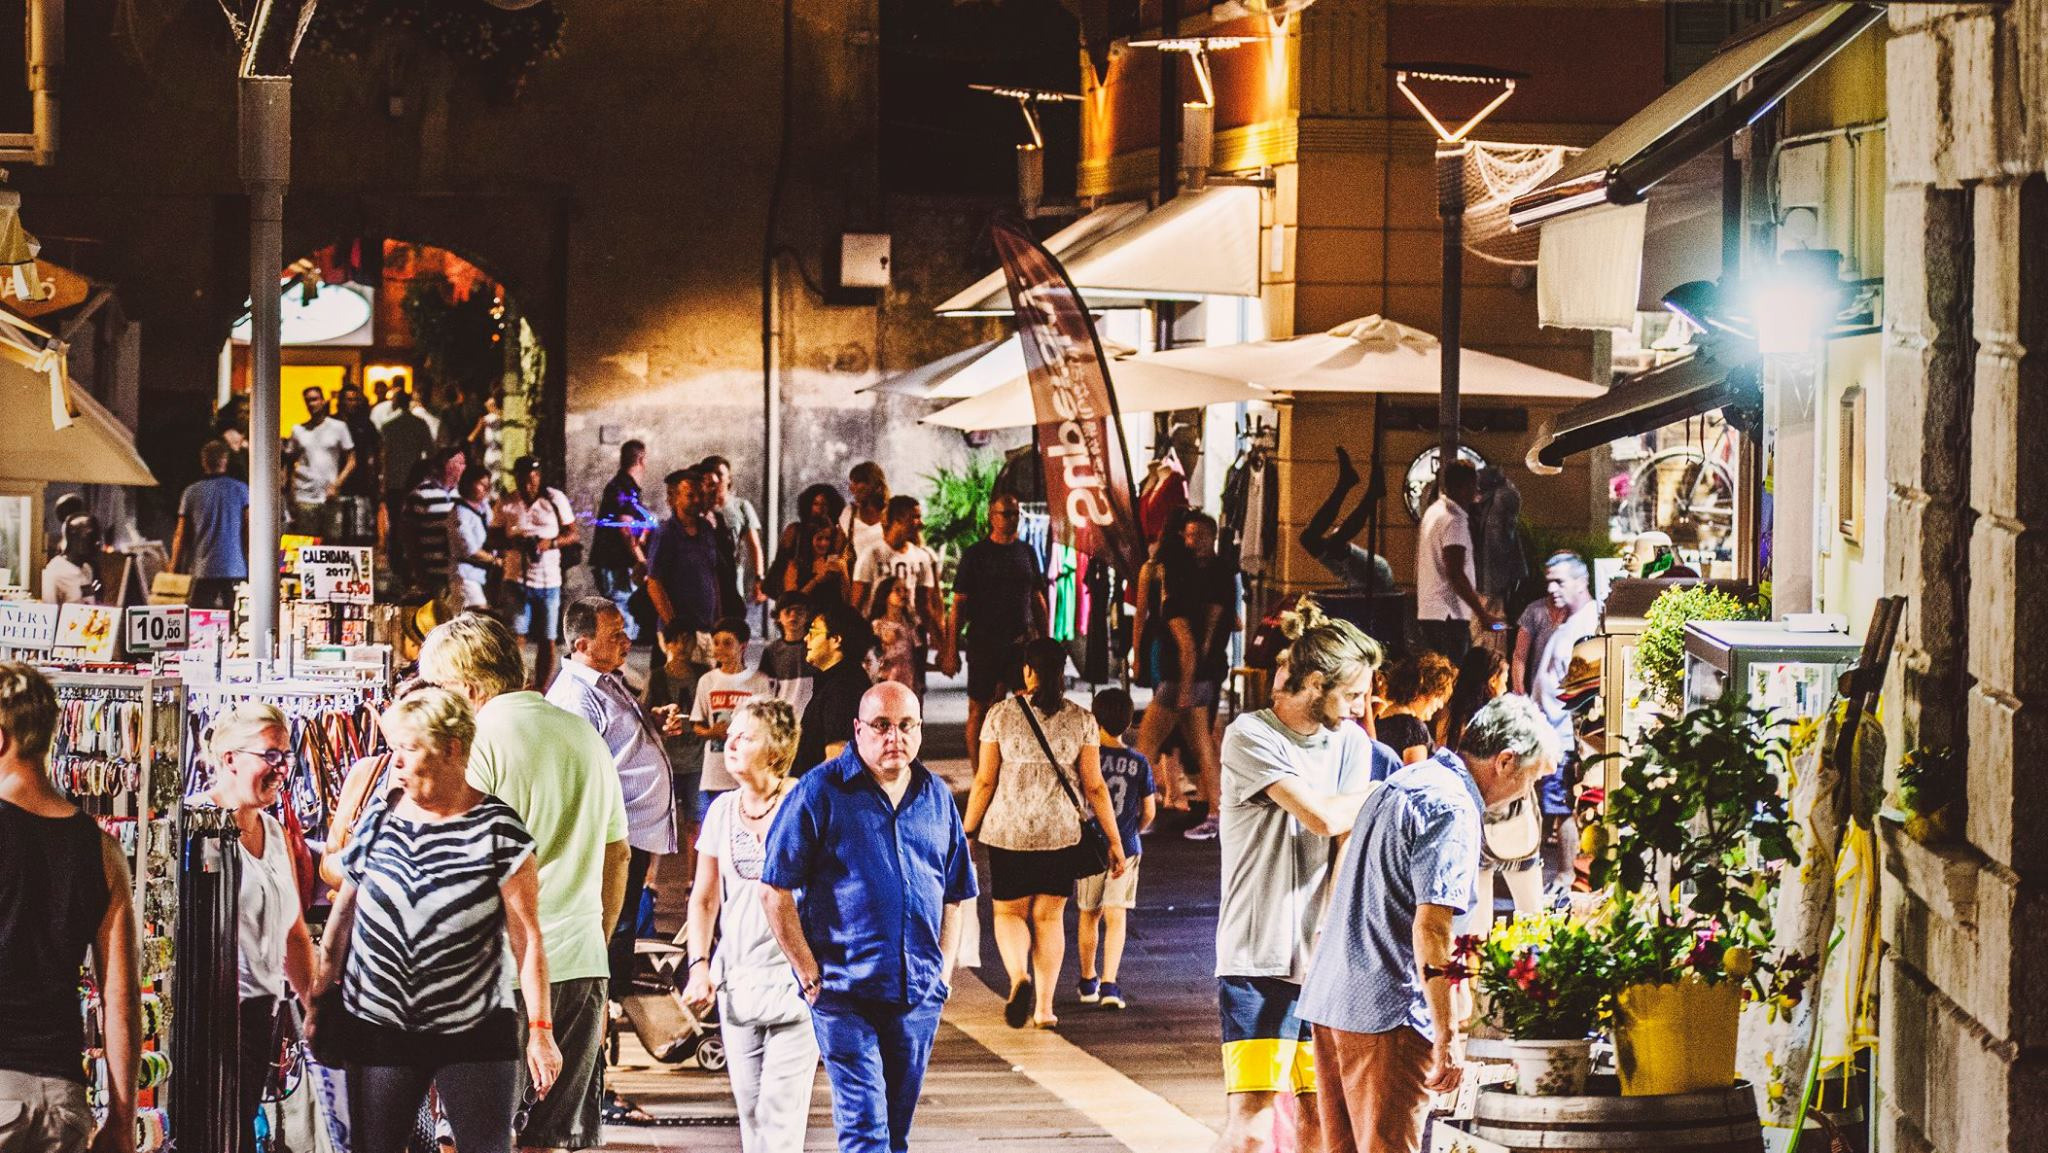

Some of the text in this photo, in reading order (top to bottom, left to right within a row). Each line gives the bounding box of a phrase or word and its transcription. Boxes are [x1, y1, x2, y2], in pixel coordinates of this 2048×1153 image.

[326, 567, 351, 577] 2017
[347, 581, 370, 596] 5,90
[137, 616, 181, 641] 10,00
